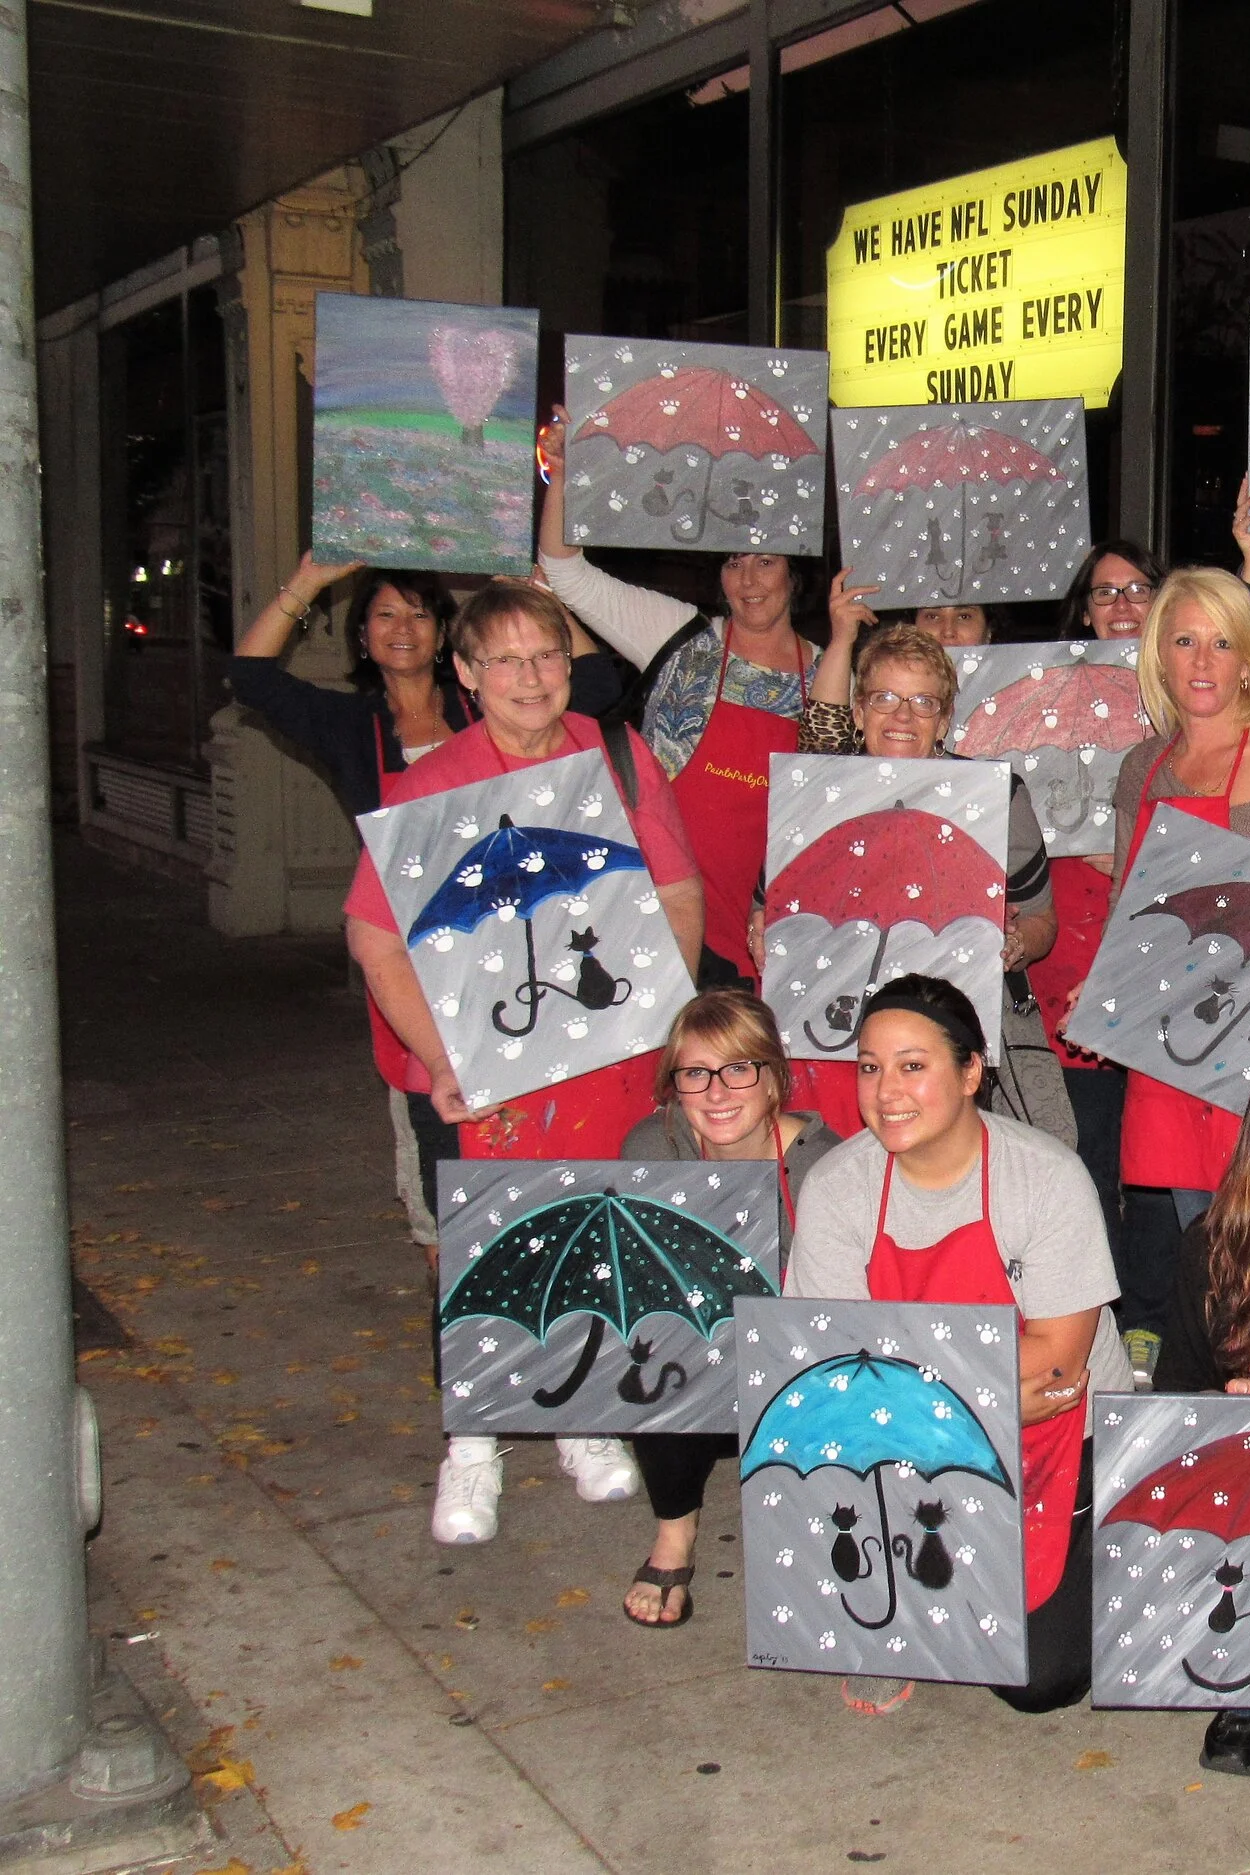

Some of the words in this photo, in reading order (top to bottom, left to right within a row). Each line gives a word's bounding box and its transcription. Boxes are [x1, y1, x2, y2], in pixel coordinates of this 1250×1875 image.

[853, 224, 881, 265] WE
[891, 210, 942, 257] HAVE
[950, 199, 989, 243] NFL
[1003, 172, 1102, 232] SUNDAY
[936, 249, 1012, 299] TICKET
[865, 319, 926, 364] EVERY
[944, 305, 1003, 350] GAME
[1022, 288, 1102, 339] EVERY
[926, 360, 1014, 404] SUNDAY
